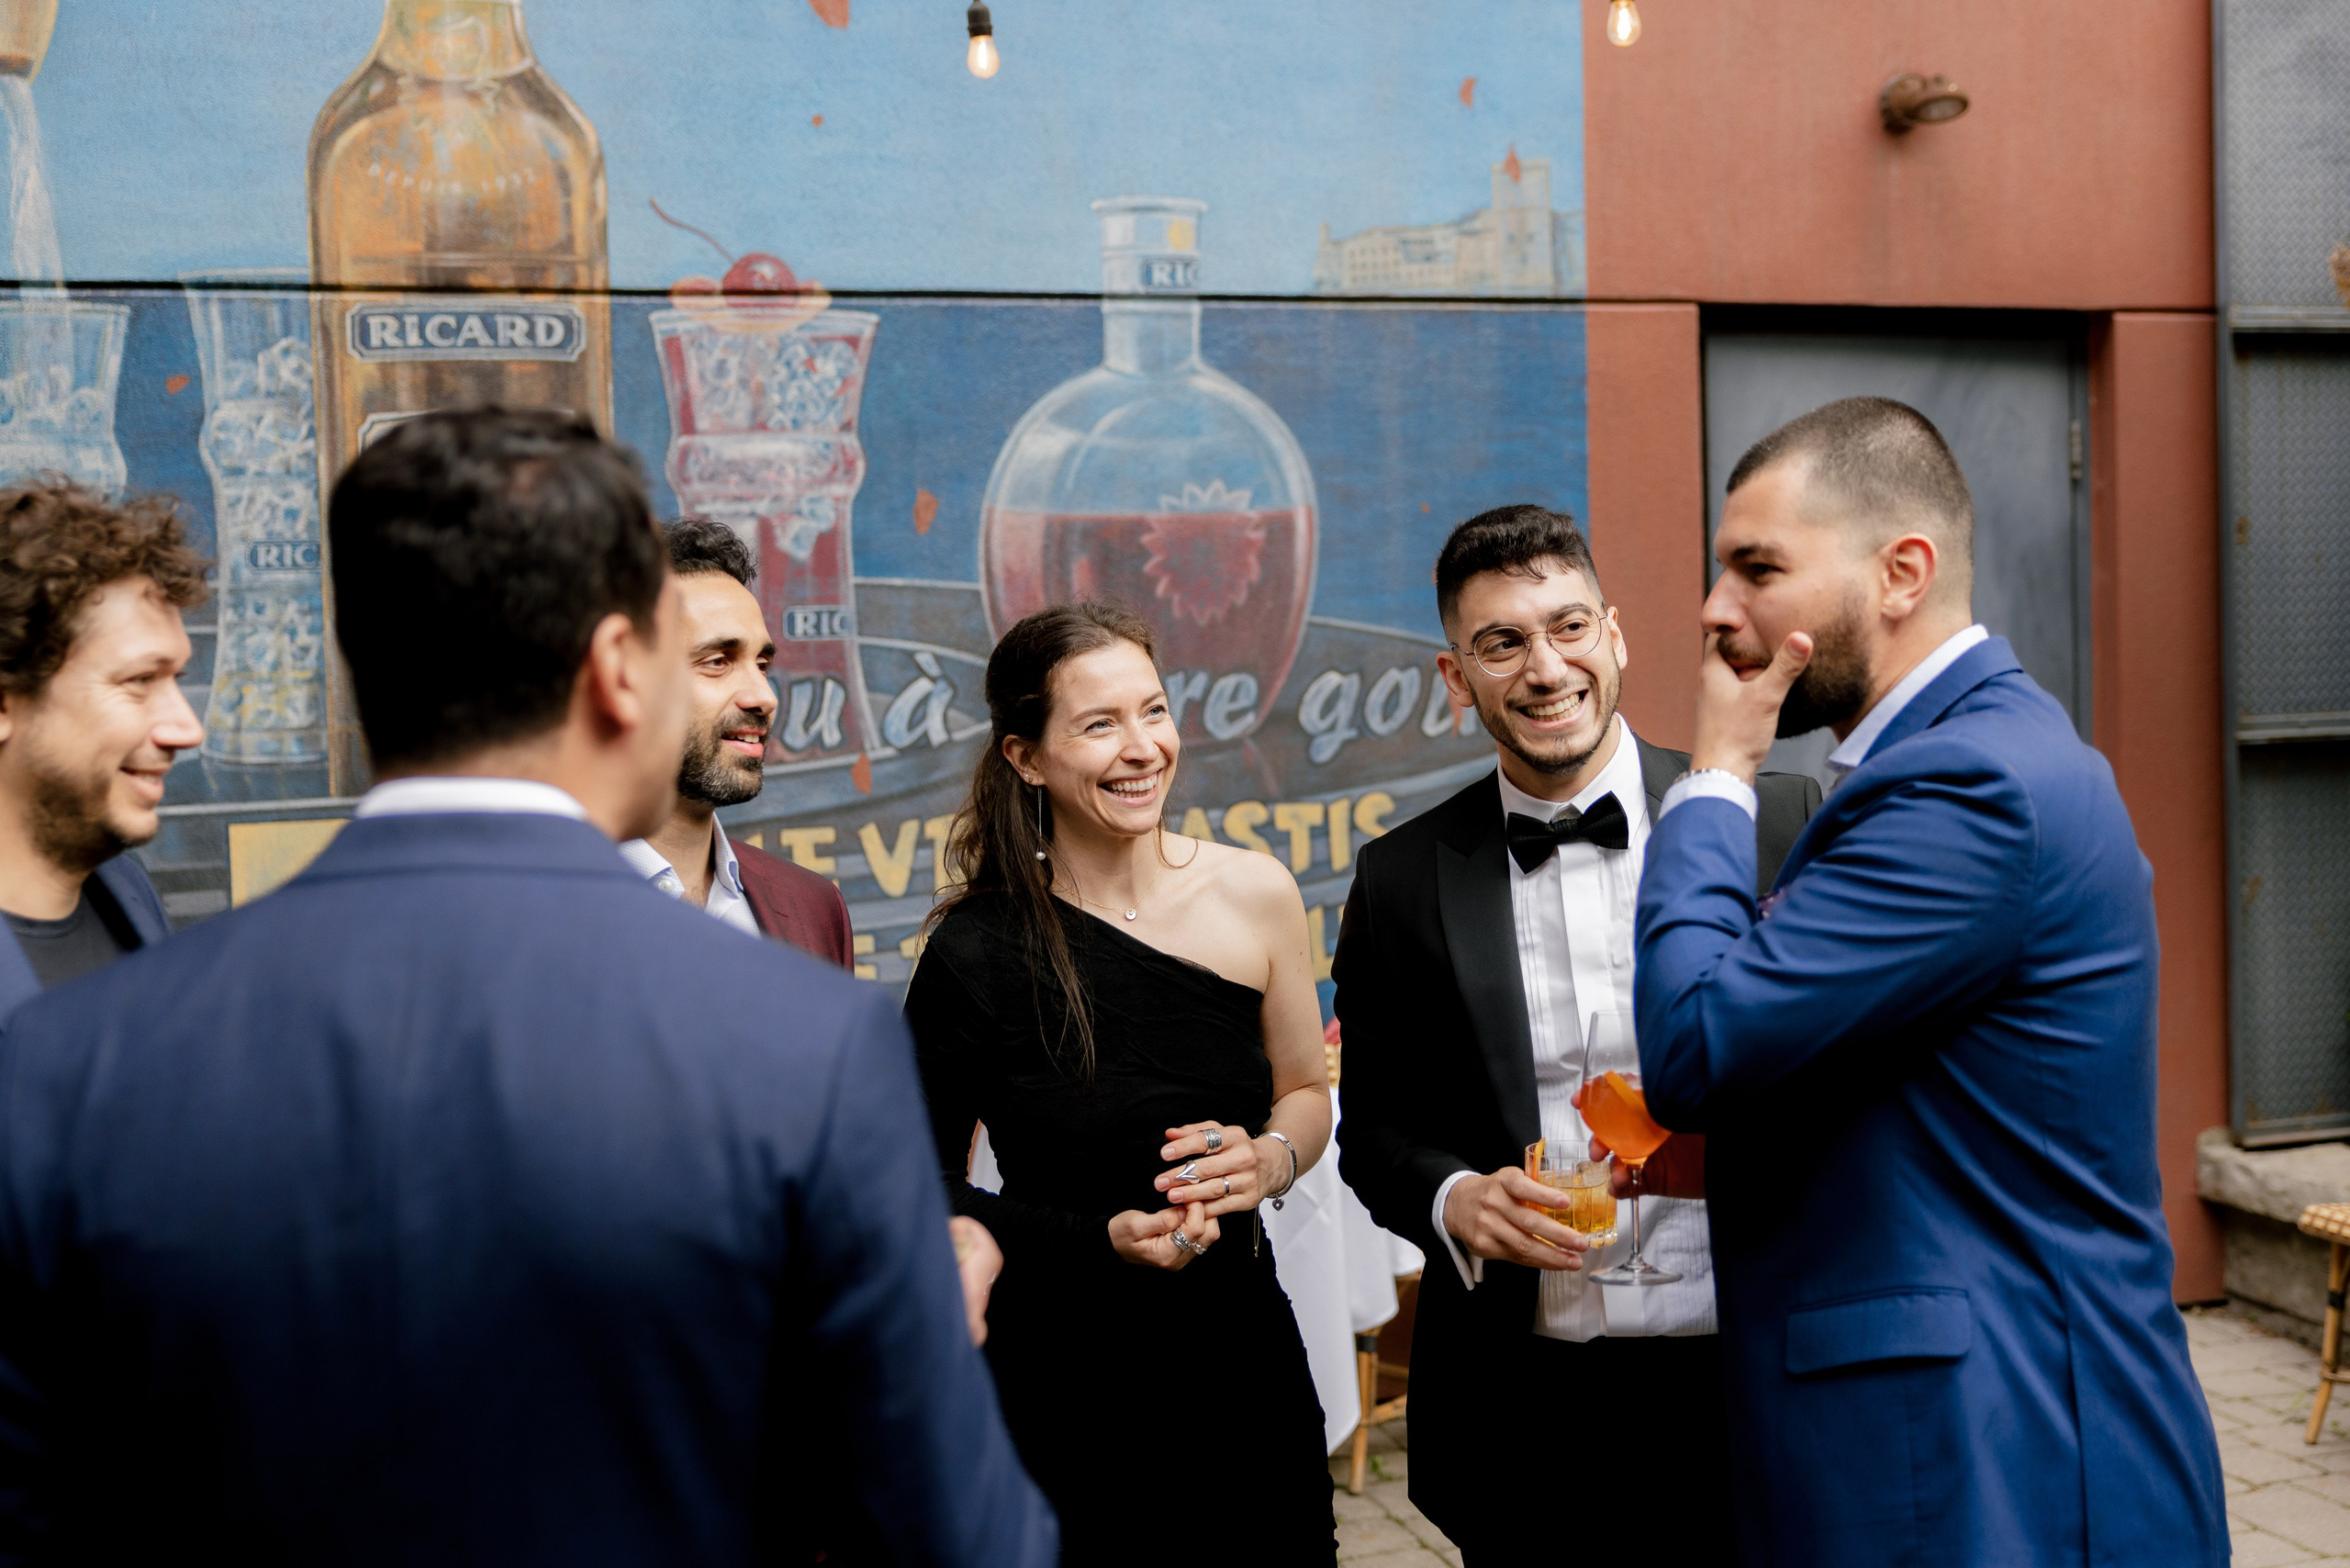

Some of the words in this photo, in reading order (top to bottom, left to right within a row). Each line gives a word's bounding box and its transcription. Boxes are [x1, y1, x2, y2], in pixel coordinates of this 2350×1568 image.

[366, 313, 565, 348] RICARD
[257, 543, 319, 567] RIC
[1164, 670, 1259, 741] re
[1298, 666, 1478, 764] gou
[1181, 791, 1395, 874] ASTIS
